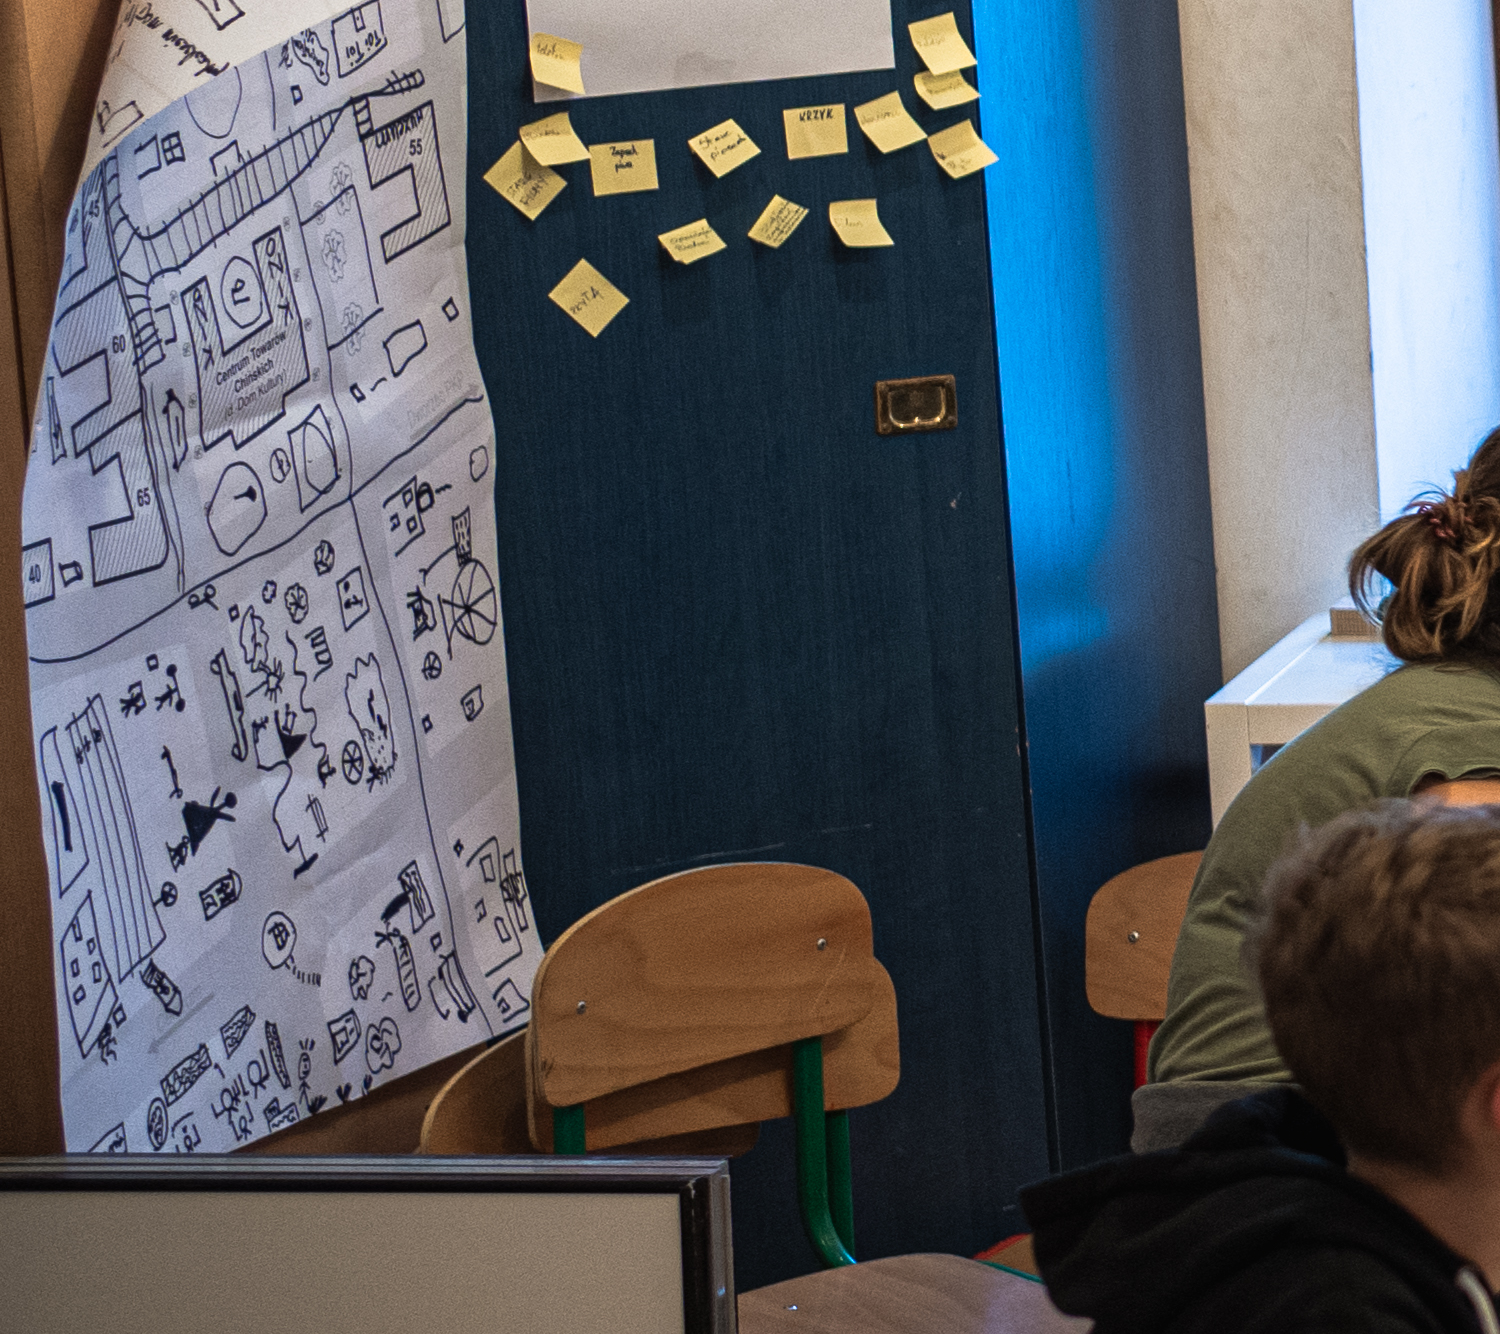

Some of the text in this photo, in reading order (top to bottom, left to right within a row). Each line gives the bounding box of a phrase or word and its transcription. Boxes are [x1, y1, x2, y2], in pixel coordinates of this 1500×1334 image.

[799, 108, 834, 122] KRZYK
[409, 138, 423, 155] 55
[88, 199, 100, 219] 45
[112, 334, 126, 353] 60
[216, 355, 251, 385] Centrum
[136, 487, 151, 507] 65
[29, 564, 42, 583] 40
